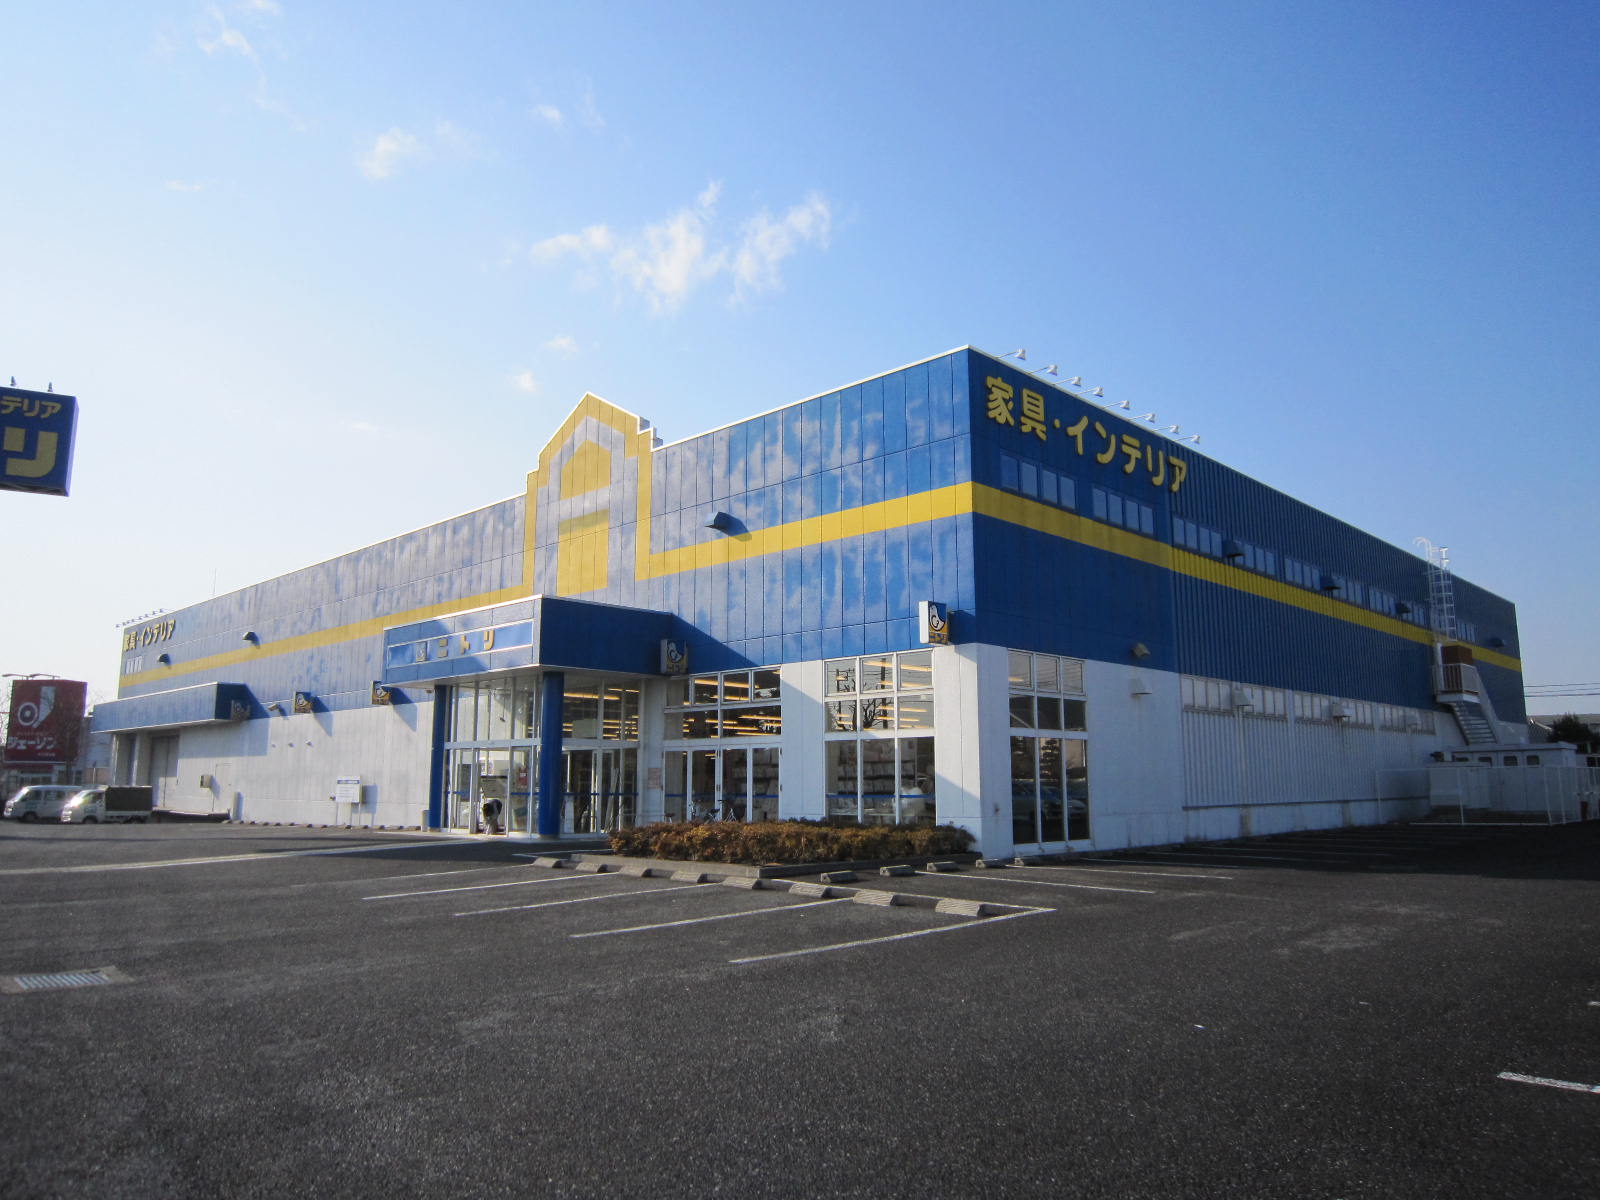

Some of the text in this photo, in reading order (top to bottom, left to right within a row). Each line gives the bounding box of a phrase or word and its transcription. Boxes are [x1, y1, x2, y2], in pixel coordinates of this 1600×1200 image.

[1, 395, 62, 418] テリア
[986, 375, 1187, 492] 家具・インテリア
[436, 630, 495, 658] ニトリ
